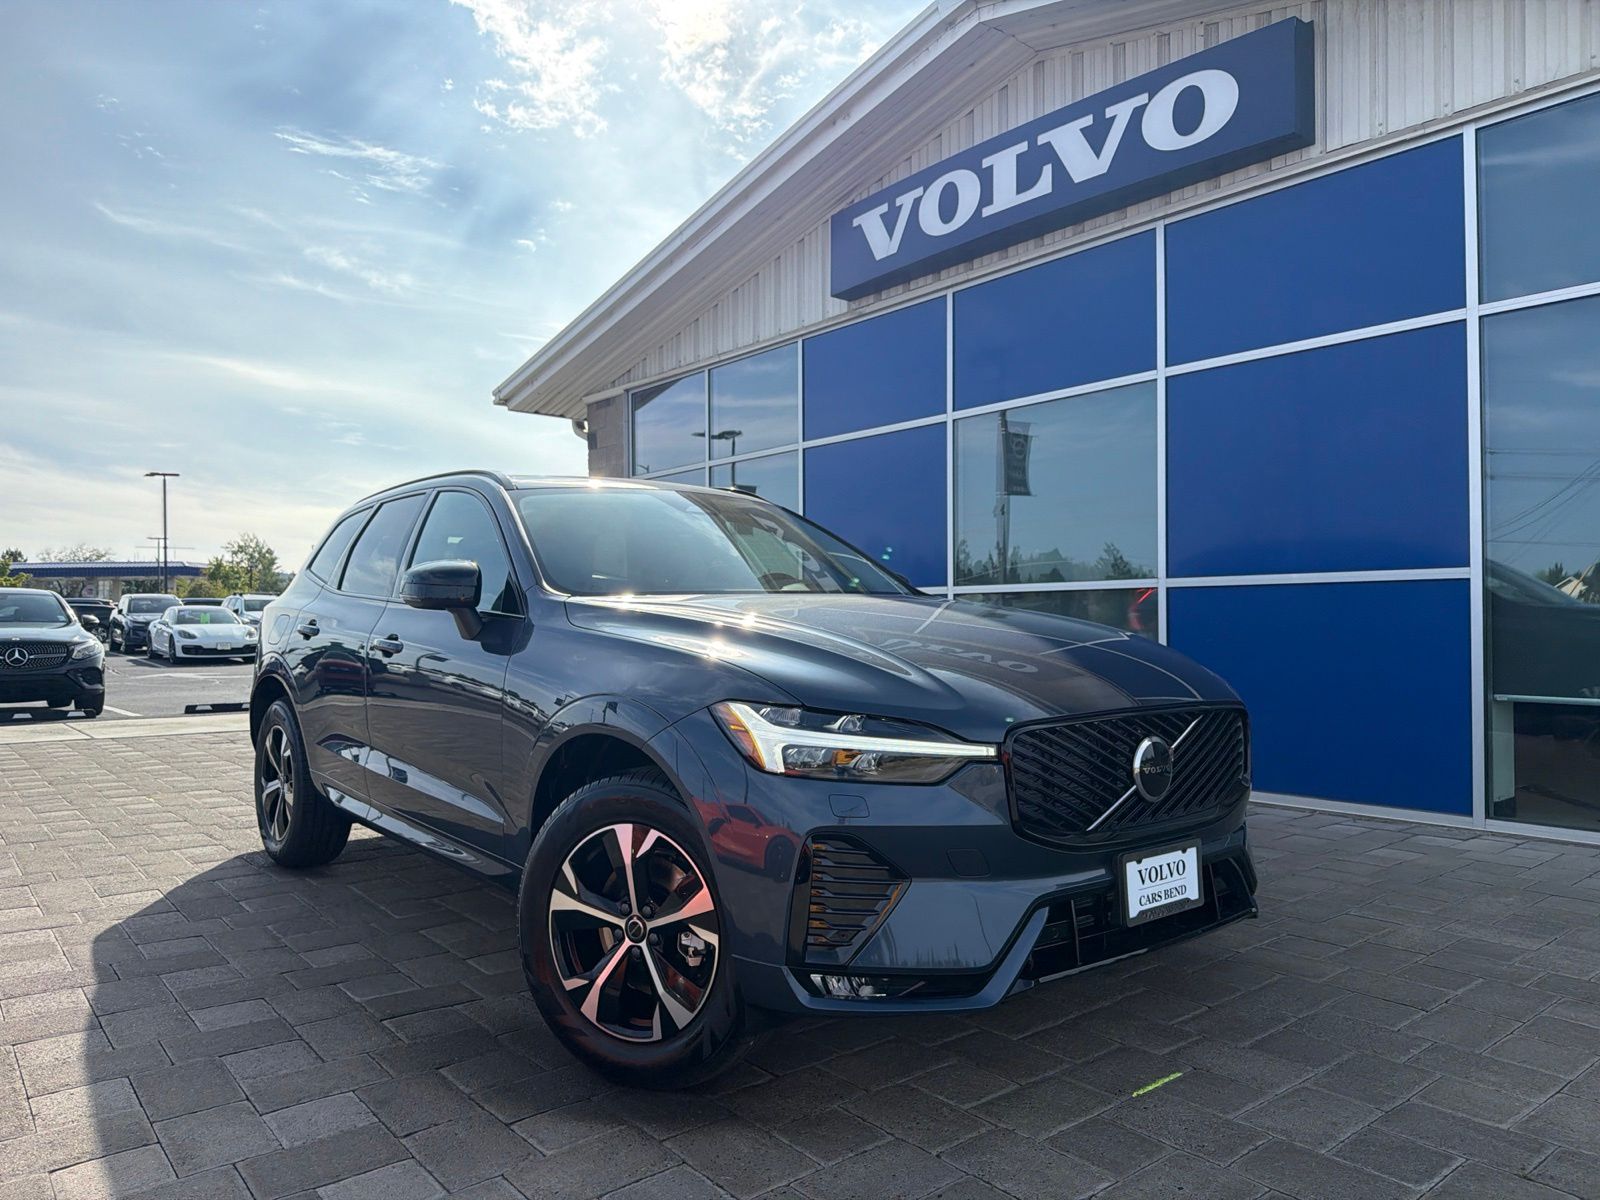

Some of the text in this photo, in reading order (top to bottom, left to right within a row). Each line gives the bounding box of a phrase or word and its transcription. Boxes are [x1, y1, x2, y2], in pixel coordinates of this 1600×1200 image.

[852, 69, 1240, 262] VOLVO
[1137, 859, 1186, 886] VOLVO
[1138, 884, 1187, 907] CARS BEND
